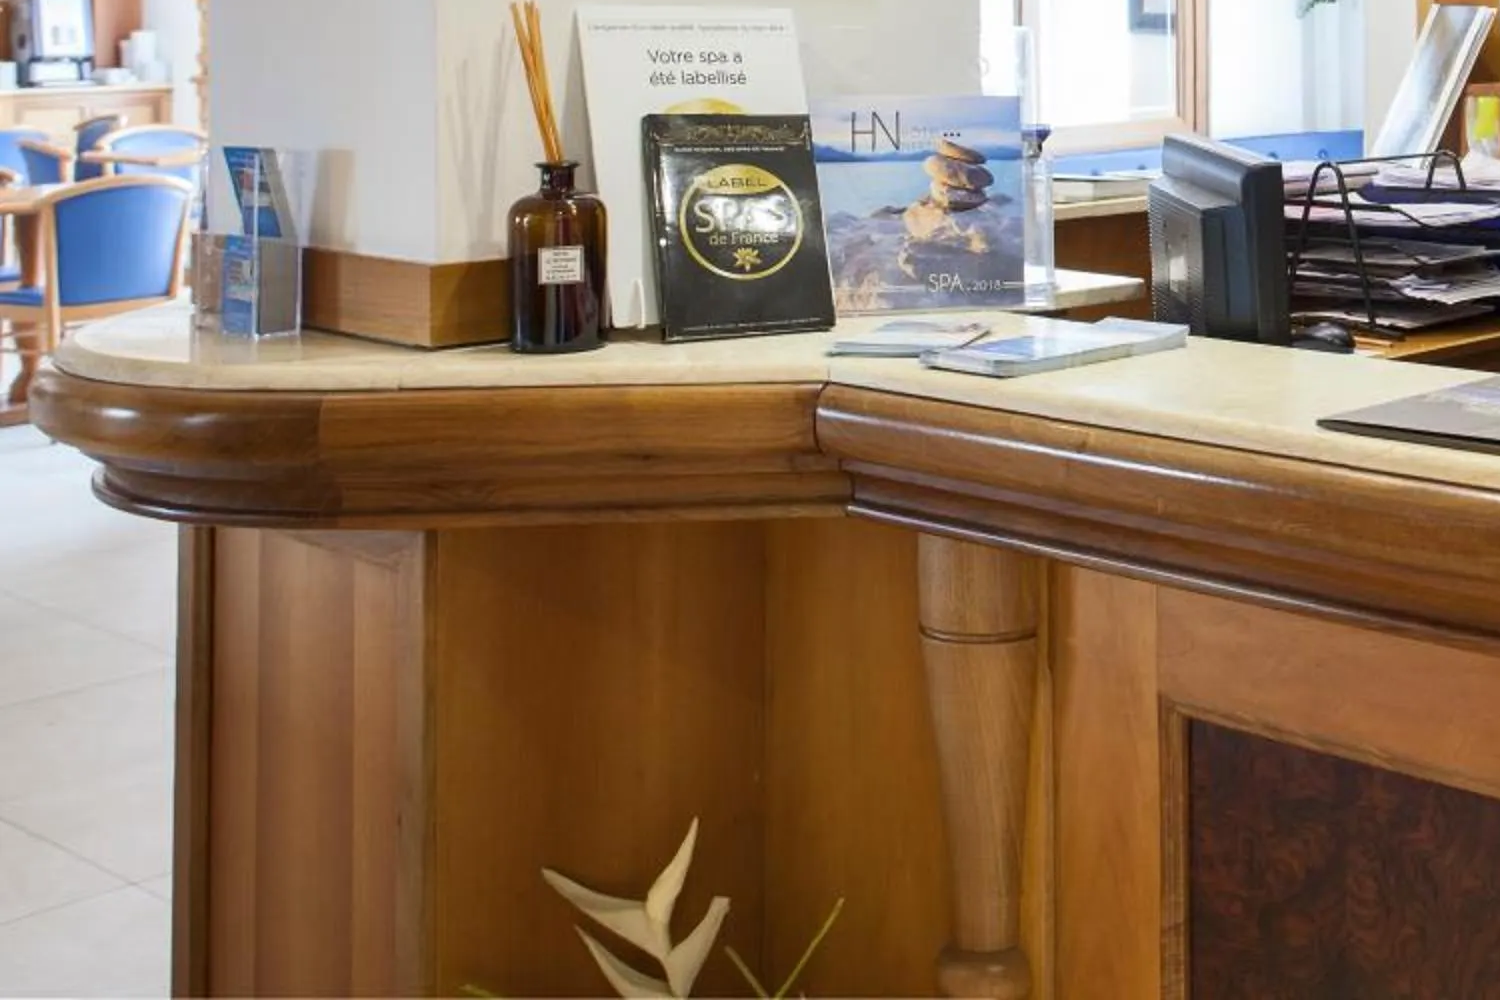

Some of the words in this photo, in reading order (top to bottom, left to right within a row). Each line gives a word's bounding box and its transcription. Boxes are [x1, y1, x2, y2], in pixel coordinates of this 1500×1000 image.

[647, 49, 693, 64] Votre
[699, 51, 728, 64] spa
[733, 52, 743, 64] a
[649, 70, 676, 86] été
[681, 69, 746, 85] labellisé
[707, 177, 768, 188] LABEL
[709, 232, 727, 245] de
[731, 231, 779, 245] France
[928, 272, 964, 293] SPA
